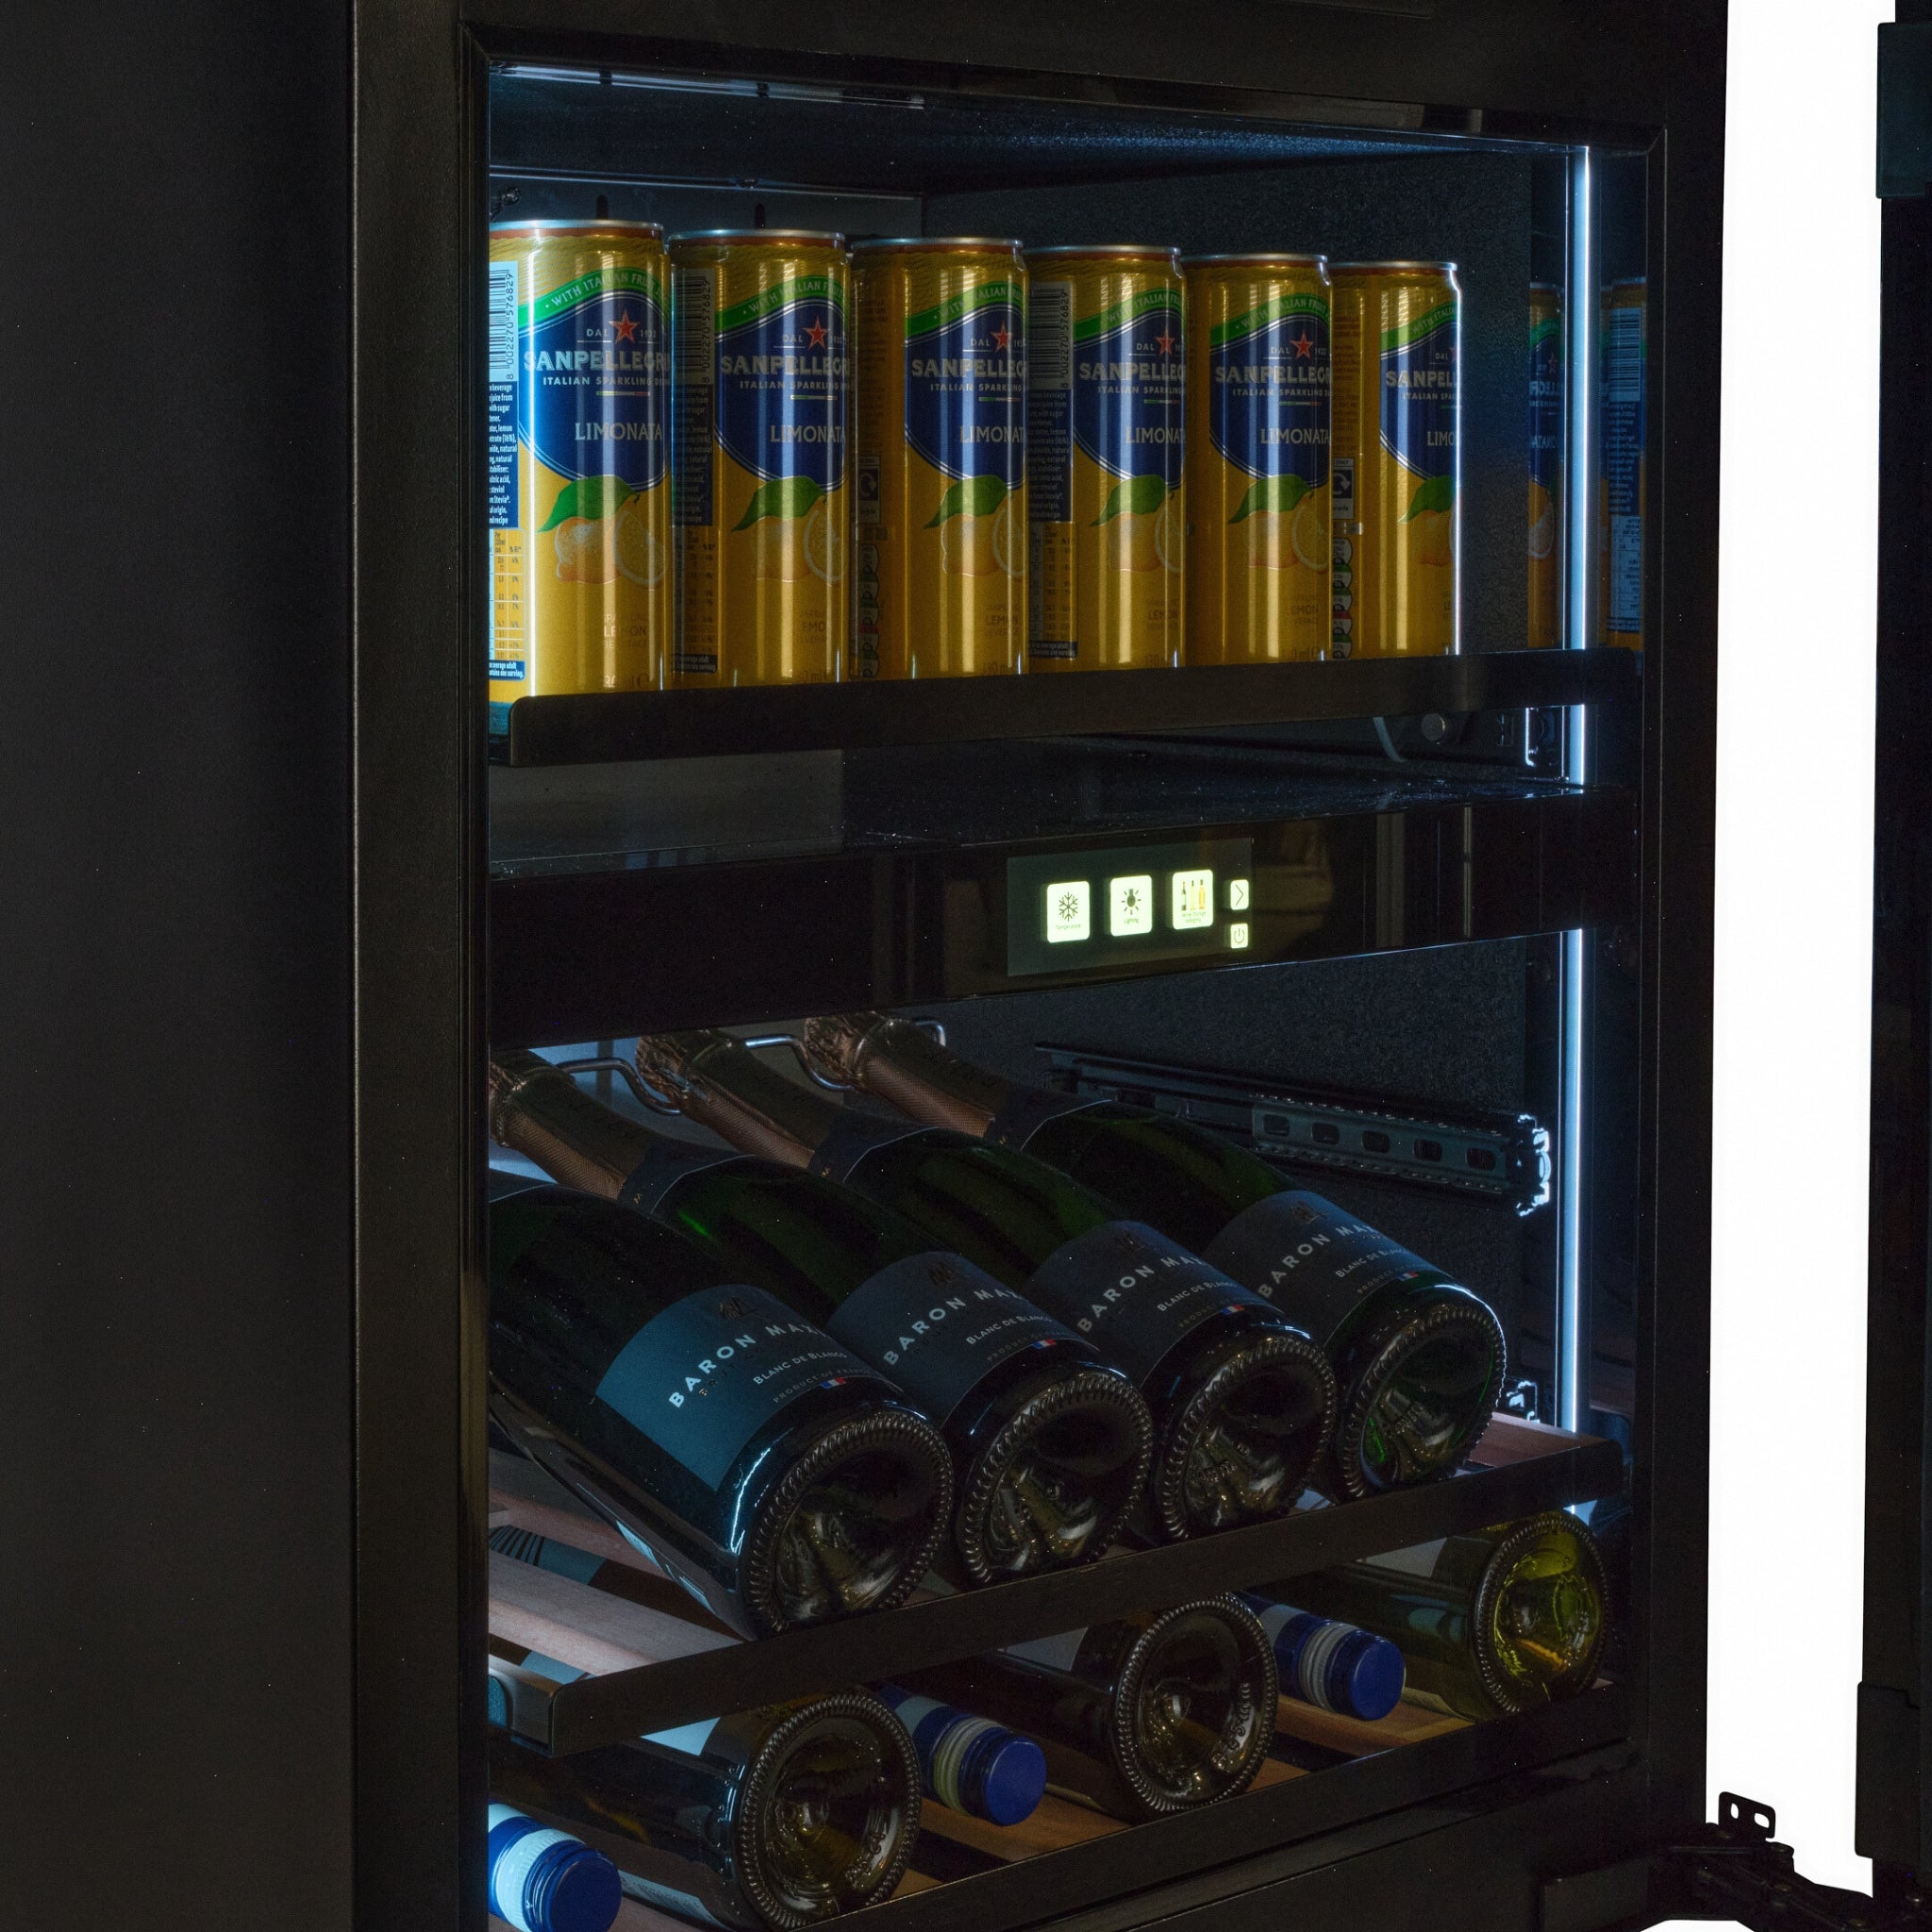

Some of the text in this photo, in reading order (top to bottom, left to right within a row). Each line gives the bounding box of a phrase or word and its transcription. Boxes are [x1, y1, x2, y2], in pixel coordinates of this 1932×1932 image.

[506, 274, 514, 315] 576829
[551, 285, 582, 307] WITH
[1059, 291, 1069, 331] 576829
[506, 322, 514, 364] 002270
[586, 328, 609, 339] DAL
[782, 334, 804, 343] DAL
[970, 339, 991, 347] DAL
[1059, 336, 1069, 375] 002270
[1136, 342, 1155, 351] DAL
[1270, 346, 1291, 355] DAL
[1435, 352, 1448, 360] DAL
[542, 376, 590, 386] ITALIAN
[595, 376, 651, 386] SPARKLING
[740, 380, 785, 390] ITALIAN
[930, 383, 1022, 391] ITALIAN SPARKING
[1098, 386, 1140, 394] ITALIAN
[1232, 388, 1274, 396] ITALIAN
[575, 422, 663, 441] LIMONATA
[1257, 1233, 1331, 1299] BARON
[1335, 1257, 1367, 1277] BLANC
[1366, 1252, 1380, 1260] DE
[1076, 1265, 1155, 1333] BARON
[1157, 1291, 1191, 1312] BLANC
[1191, 1284, 1206, 1293] DE
[883, 1297, 967, 1366] BARON
[965, 1323, 1002, 1344] BLANC
[1002, 1316, 1017, 1326] DE
[668, 1334, 757, 1408] BARON
[753, 1361, 791, 1385] BLANC
[792, 1355, 808, 1365] DE
